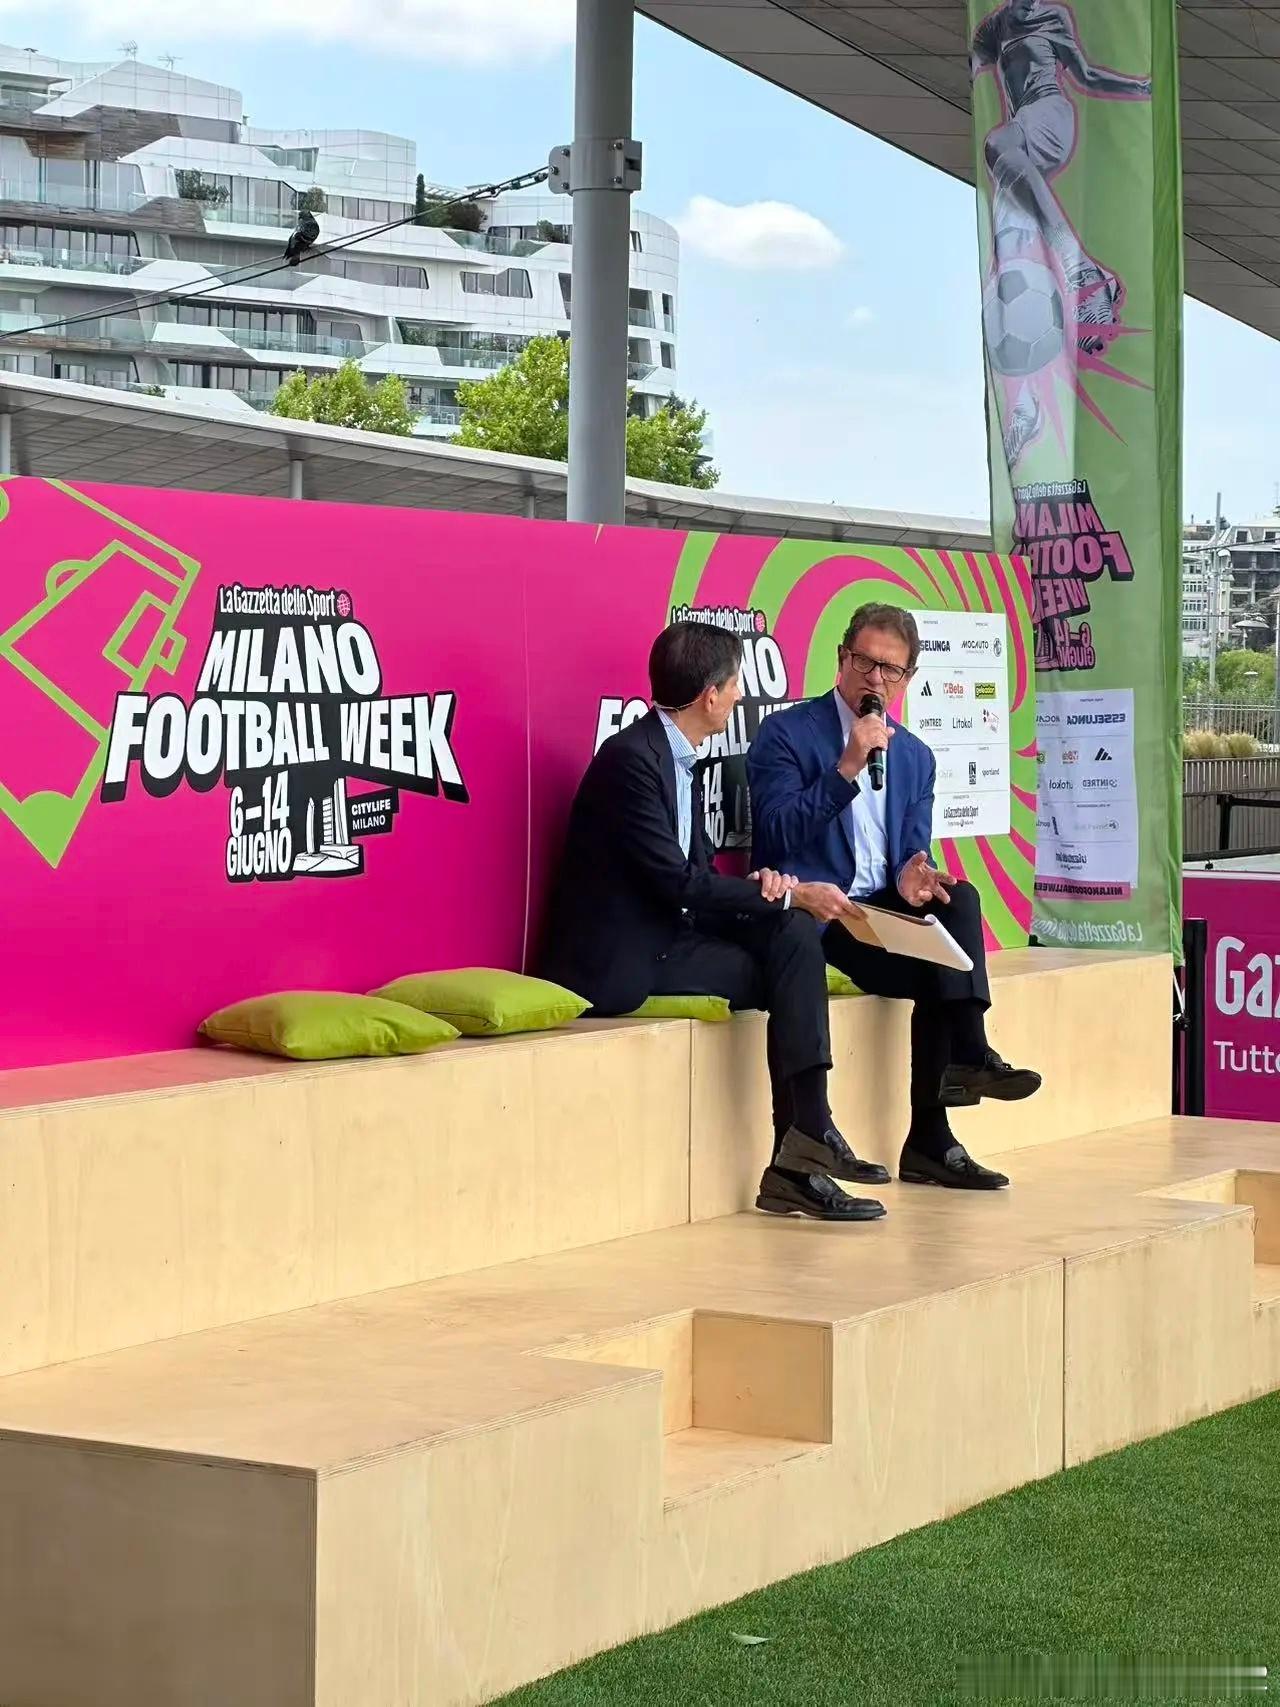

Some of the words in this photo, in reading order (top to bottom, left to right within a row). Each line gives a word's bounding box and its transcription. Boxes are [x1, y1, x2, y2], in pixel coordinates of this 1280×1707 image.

[306, 588, 336, 621] Sport
[196, 622, 381, 696] MILANO
[919, 639, 951, 652] SELUNGA
[105, 693, 330, 784] FOOTBALL
[340, 693, 464, 786] WEEK
[952, 717, 973, 729] Litokol
[352, 815, 386, 831] MILANO
[227, 831, 292, 876] GIUGNO
